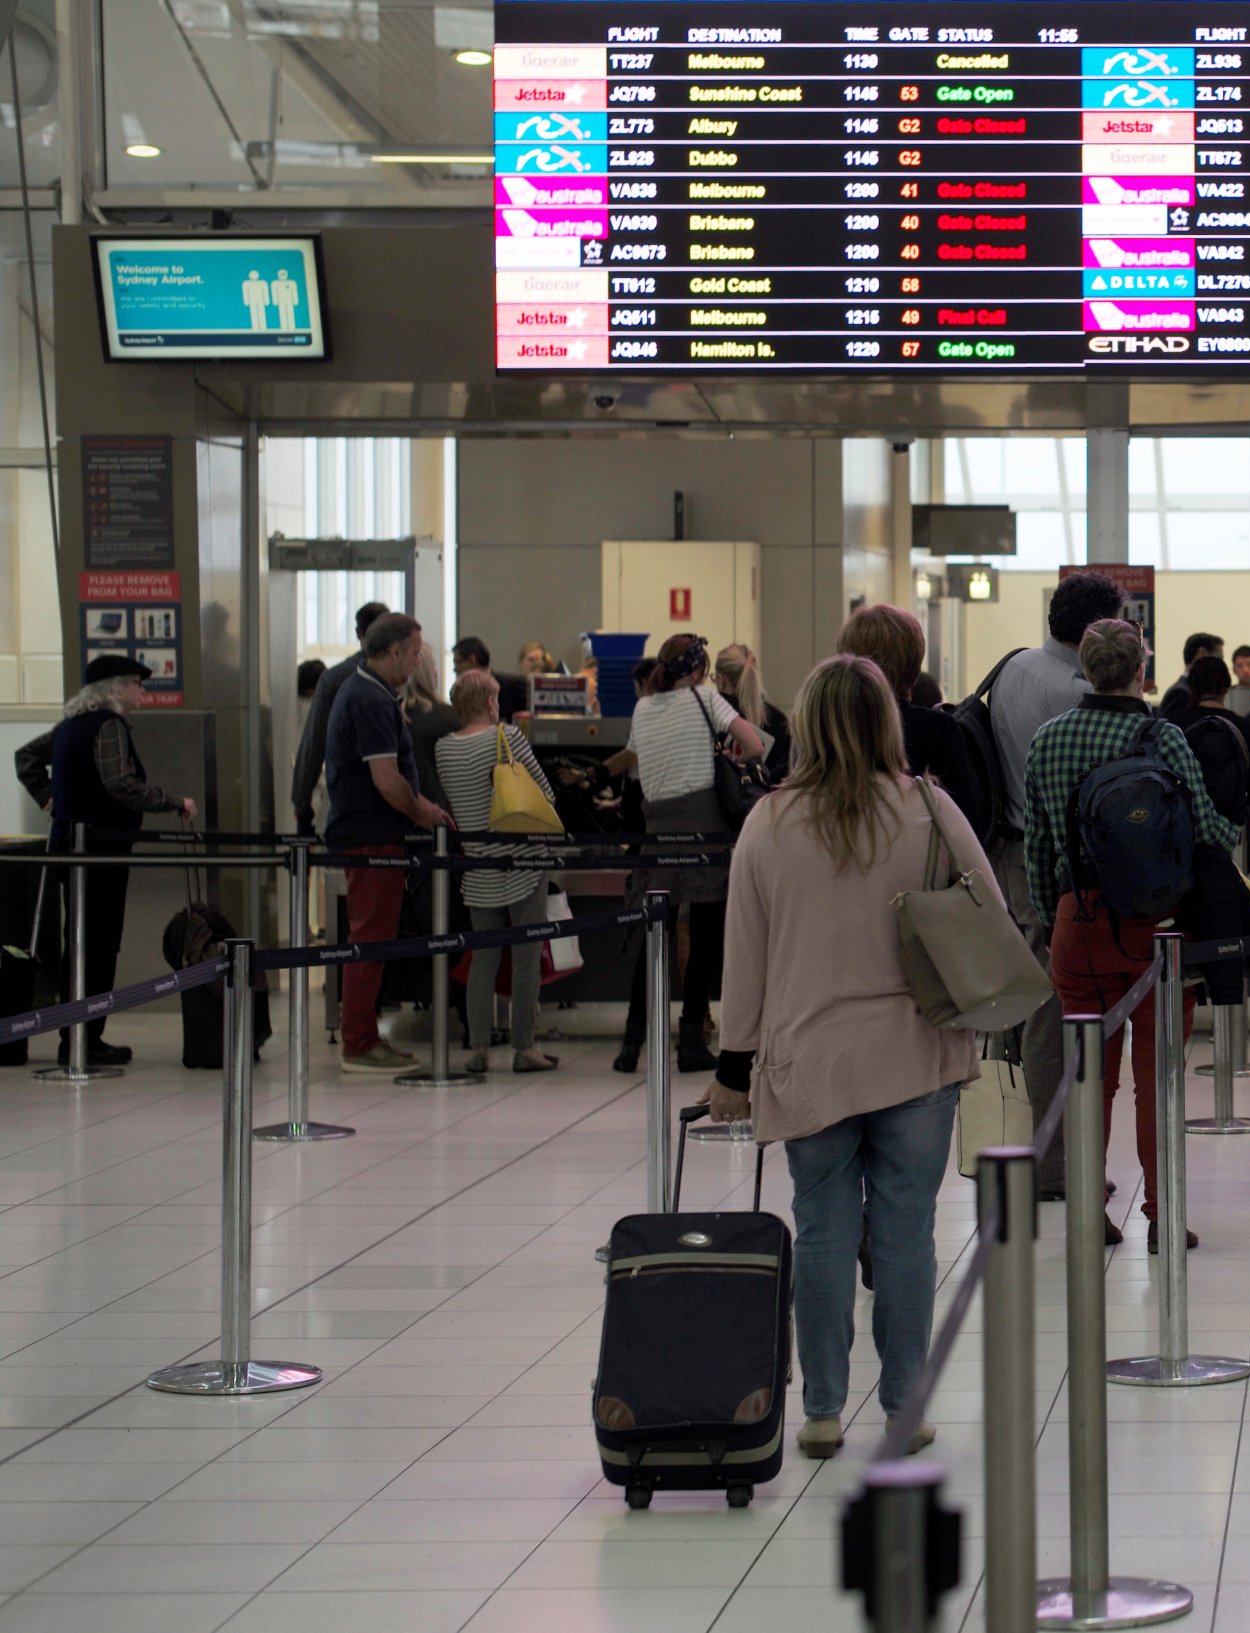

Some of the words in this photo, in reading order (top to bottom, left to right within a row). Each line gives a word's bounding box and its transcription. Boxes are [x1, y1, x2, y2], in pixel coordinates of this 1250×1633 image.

[608, 27, 659, 41] FLIGHT
[687, 28, 781, 42] DESTINATION
[844, 27, 879, 41] TIME
[889, 28, 929, 41] GATE
[937, 29, 993, 42] STATUS
[1038, 29, 1078, 43] 11:55
[1195, 28, 1247, 41] FLIGHT
[688, 54, 765, 69] Melbourne
[937, 54, 1008, 68] Cancelled
[515, 88, 565, 101] Jetstar
[689, 86, 757, 101] Sunshine
[759, 86, 802, 101] Coast
[844, 86, 878, 101] 1145
[900, 86, 918, 101] 53
[937, 86, 972, 101] Gate
[974, 86, 1013, 103] Open
[1196, 87, 1242, 101] ZL174
[609, 119, 654, 134] ZL773
[688, 119, 737, 136] Albury
[844, 119, 878, 133] 1145
[898, 118, 920, 133] G2
[937, 118, 972, 133] Gate
[974, 118, 1026, 133] Closed
[1103, 120, 1153, 133] Jetstar
[689, 151, 737, 165] Dubbo
[844, 151, 879, 165] 1145
[898, 151, 920, 165] G2
[690, 183, 765, 198] Melbourne
[900, 183, 918, 197] 41
[937, 183, 972, 198] Gate
[974, 183, 1026, 198] Closed
[690, 215, 754, 230] Brisbane
[901, 215, 920, 230] 40
[938, 215, 972, 230] Gate
[974, 215, 1026, 230] Closed
[690, 245, 754, 259] Brisbane
[901, 245, 920, 259] 40
[938, 244, 972, 259] Gate
[974, 244, 1026, 259] Closed
[116, 265, 168, 274] Welcome
[171, 265, 184, 274] to
[117, 275, 158, 286] Sydney
[690, 278, 725, 292] Gold
[728, 278, 771, 292] Coast
[845, 278, 879, 292] 1210
[1110, 276, 1169, 289] DELTA
[1198, 275, 1250, 290] DL7276
[517, 312, 567, 325] Jetstar
[691, 310, 766, 324] Melbourne
[901, 310, 920, 324] 49
[938, 309, 975, 324] Final
[977, 309, 1006, 324] Call
[518, 344, 567, 357] Jetstar
[691, 342, 755, 357] Hamilton
[758, 342, 775, 357] Is.
[938, 342, 973, 357] Gate
[976, 342, 1014, 359] Open
[1089, 336, 1190, 353] ETIHAD
[89, 575, 125, 585] PLEASE
[128, 575, 170, 585] REMOVE
[88, 587, 117, 596] FROM
[120, 587, 148, 596] YOUR
[152, 587, 172, 596] BAG
[159, 696, 178, 704] TRAY
